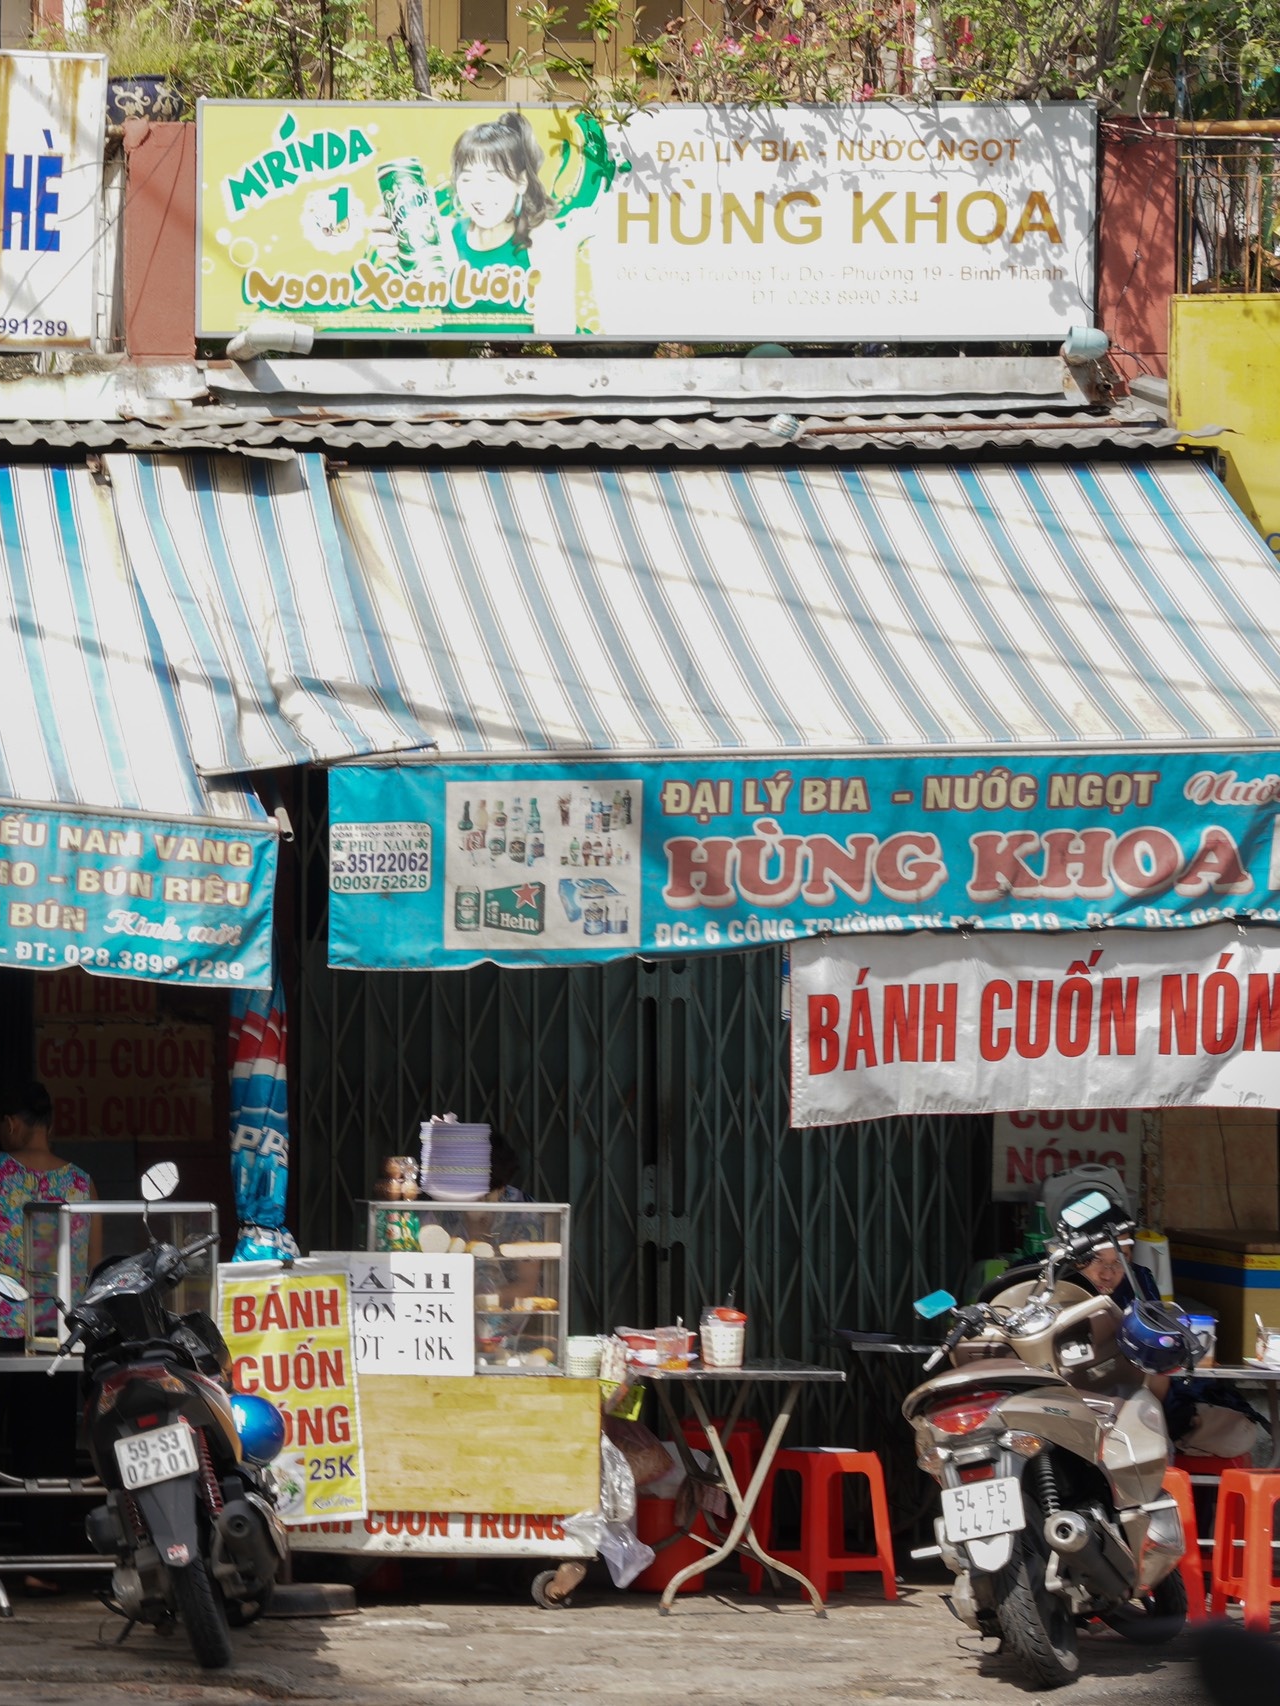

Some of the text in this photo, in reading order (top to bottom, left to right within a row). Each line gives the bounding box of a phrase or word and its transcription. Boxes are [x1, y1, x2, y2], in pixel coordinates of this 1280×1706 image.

[227, 113, 374, 212] MIRINDA
[656, 133, 1021, 168] ĐẠI LÝ BIA NƯỚC NGỌT
[329, 187, 349, 226] 1
[617, 179, 1064, 246] HÙNG KHOA
[247, 269, 352, 307] Ngon
[924, 267, 942, 281] 19
[660, 766, 1162, 825] ĐẠI LÝ BIA NƯỚC NGỌT
[58, 824, 143, 858] NAM
[153, 832, 253, 868] VANG
[347, 852, 429, 874] 35122062
[662, 817, 1254, 910] HÙNG KHOA
[76, 865, 153, 900] BÚN
[163, 873, 252, 909] RIÊU
[333, 874, 428, 891] 0903752628
[9, 897, 87, 933] BÚN
[704, 924, 721, 944] 6
[727, 914, 798, 943] CÔNG
[807, 967, 958, 1075] BÁNH
[979, 949, 1139, 1062] CUỐN
[232, 1285, 341, 1334] BÁNH
[232, 1338, 346, 1394] CUỐN
[283, 1401, 352, 1448] ÓNG
[126, 1430, 181, 1461] 59-S3
[308, 1455, 356, 1481] 25K
